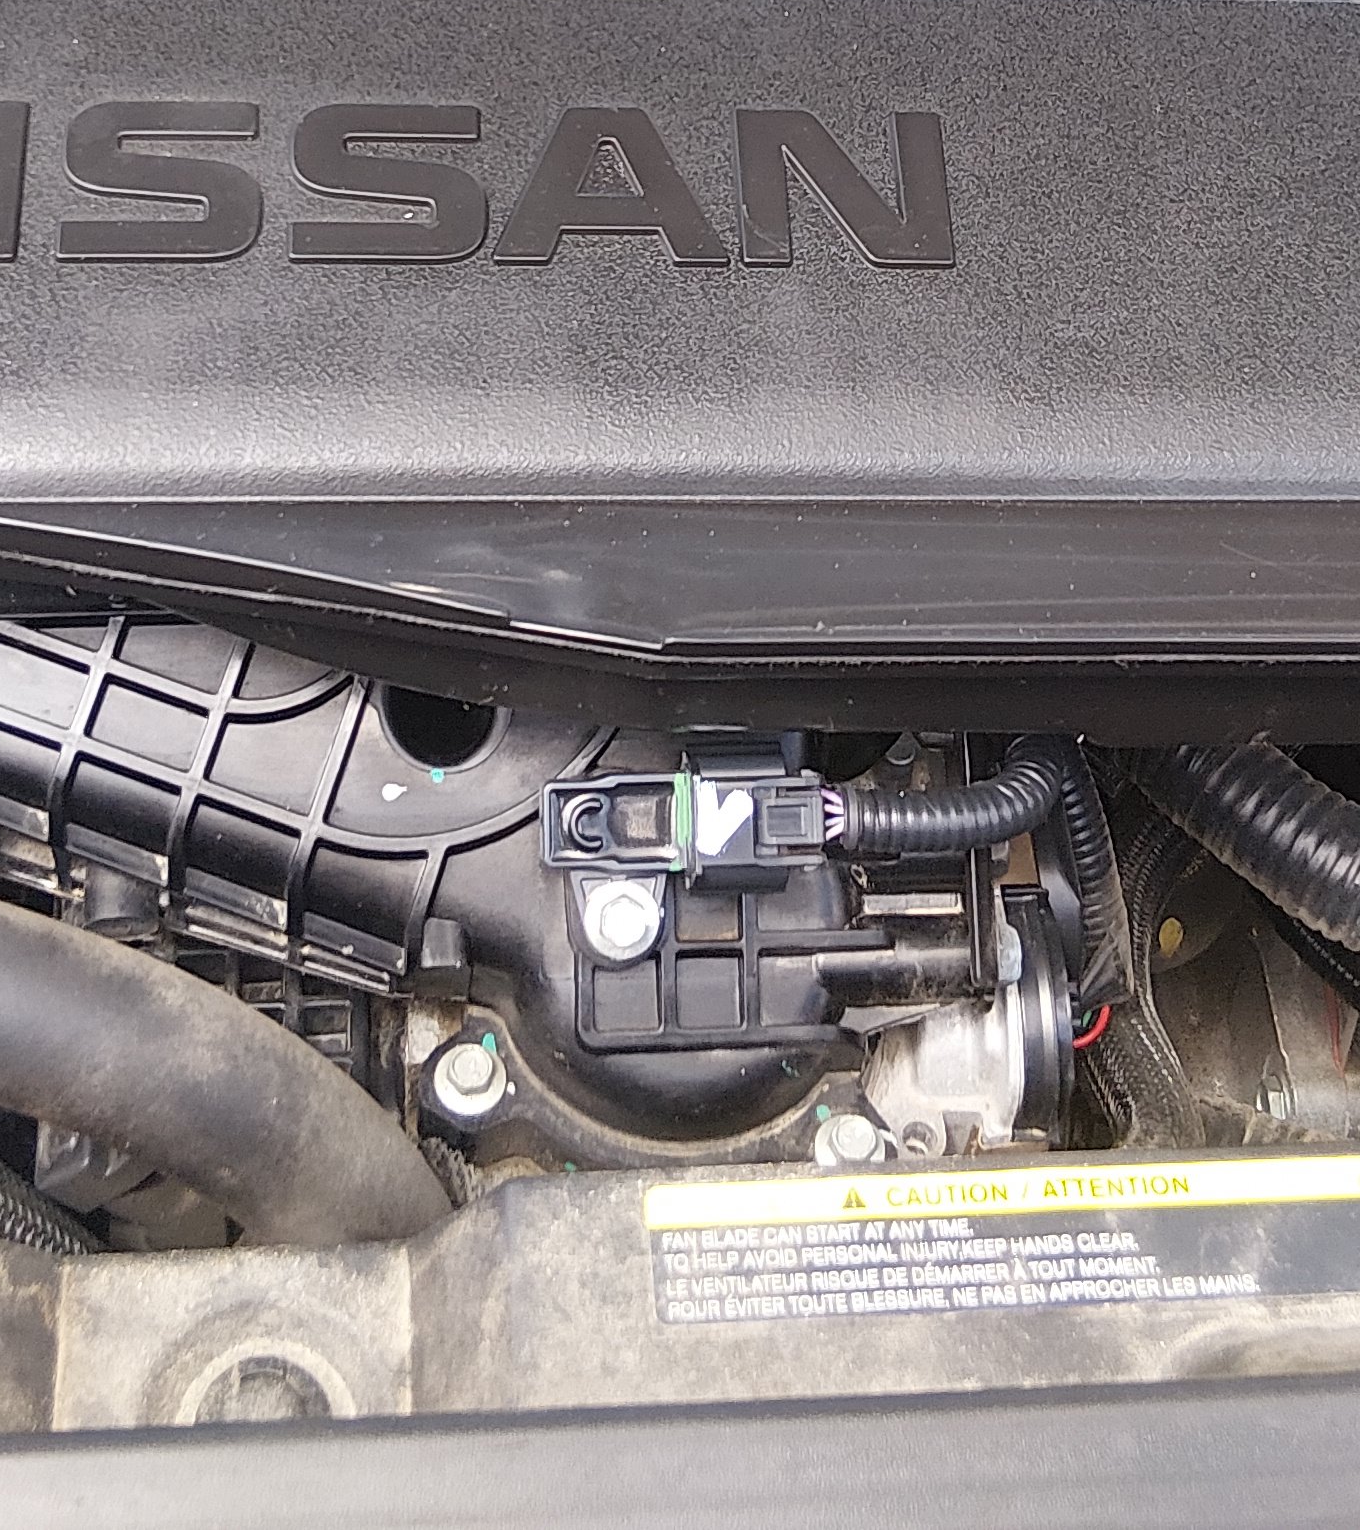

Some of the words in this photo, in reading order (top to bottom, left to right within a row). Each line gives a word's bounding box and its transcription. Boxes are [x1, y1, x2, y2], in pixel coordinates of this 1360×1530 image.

[886, 1182, 1008, 1207] CAUTION
[1043, 1176, 1189, 1198] ATTENTION
[662, 1231, 696, 1252] FAN
[702, 1228, 759, 1249] BLADE
[763, 1225, 802, 1246] CAN
[806, 1222, 860, 1244] START
[864, 1221, 886, 1241] AT
[890, 1219, 924, 1240] ANY
[928, 1217, 974, 1236] TIME.
[663, 1253, 690, 1273] TO
[694, 1249, 739, 1270] HELP
[743, 1246, 797, 1268] AVOID
[802, 1241, 896, 1264] PERSONAL
[1010, 1233, 1074, 1255] HANDS
[1078, 1231, 1139, 1252] CLEAR.
[666, 1278, 688, 1297] LE
[692, 1270, 808, 1295] VENTILATEUR
[812, 1267, 878, 1291] RISQUE
[883, 1265, 908, 1287] DE
[912, 1259, 1010, 1284] DÉMARRER
[1014, 1257, 1027, 1278] À
[1028, 1259, 1075, 1279] TOUT
[1079, 1255, 1160, 1276] MOMENT.
[668, 1297, 721, 1318] POUR
[725, 1293, 785, 1316] ÉVITER
[788, 1291, 848, 1315] TOUTE
[851, 1287, 949, 1310] BLESSURE,
[954, 1285, 978, 1306] NE
[982, 1283, 1016, 1304] PAS
[1020, 1281, 1047, 1301] EN
[1049, 1277, 1160, 1301] APPROCHER
[1164, 1276, 1194, 1295] LES
[1198, 1273, 1260, 1294] MAINS.
